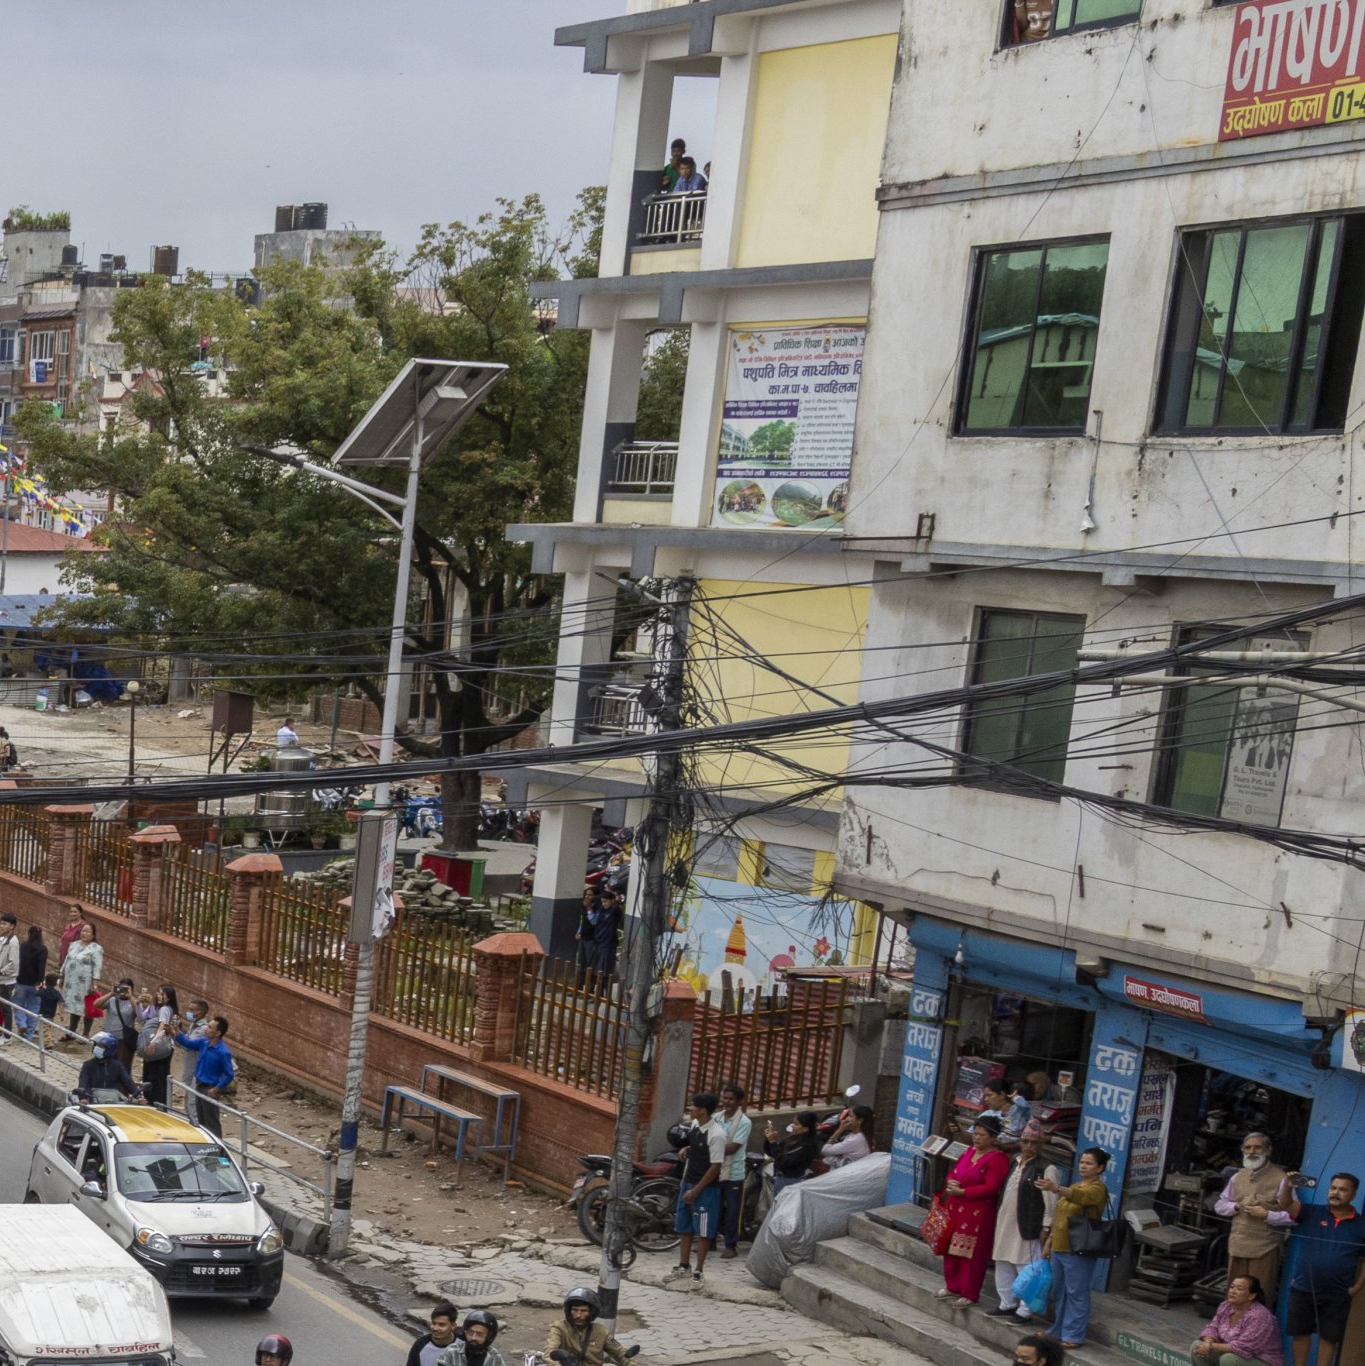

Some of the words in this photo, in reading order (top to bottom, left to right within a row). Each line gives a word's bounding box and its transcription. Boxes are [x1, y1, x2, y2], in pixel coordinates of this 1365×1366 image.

[1288, 92, 1326, 126] कला
[1094, 1043, 1138, 1078] ढक
[1130, 1339, 1162, 1363] TRAVELS
